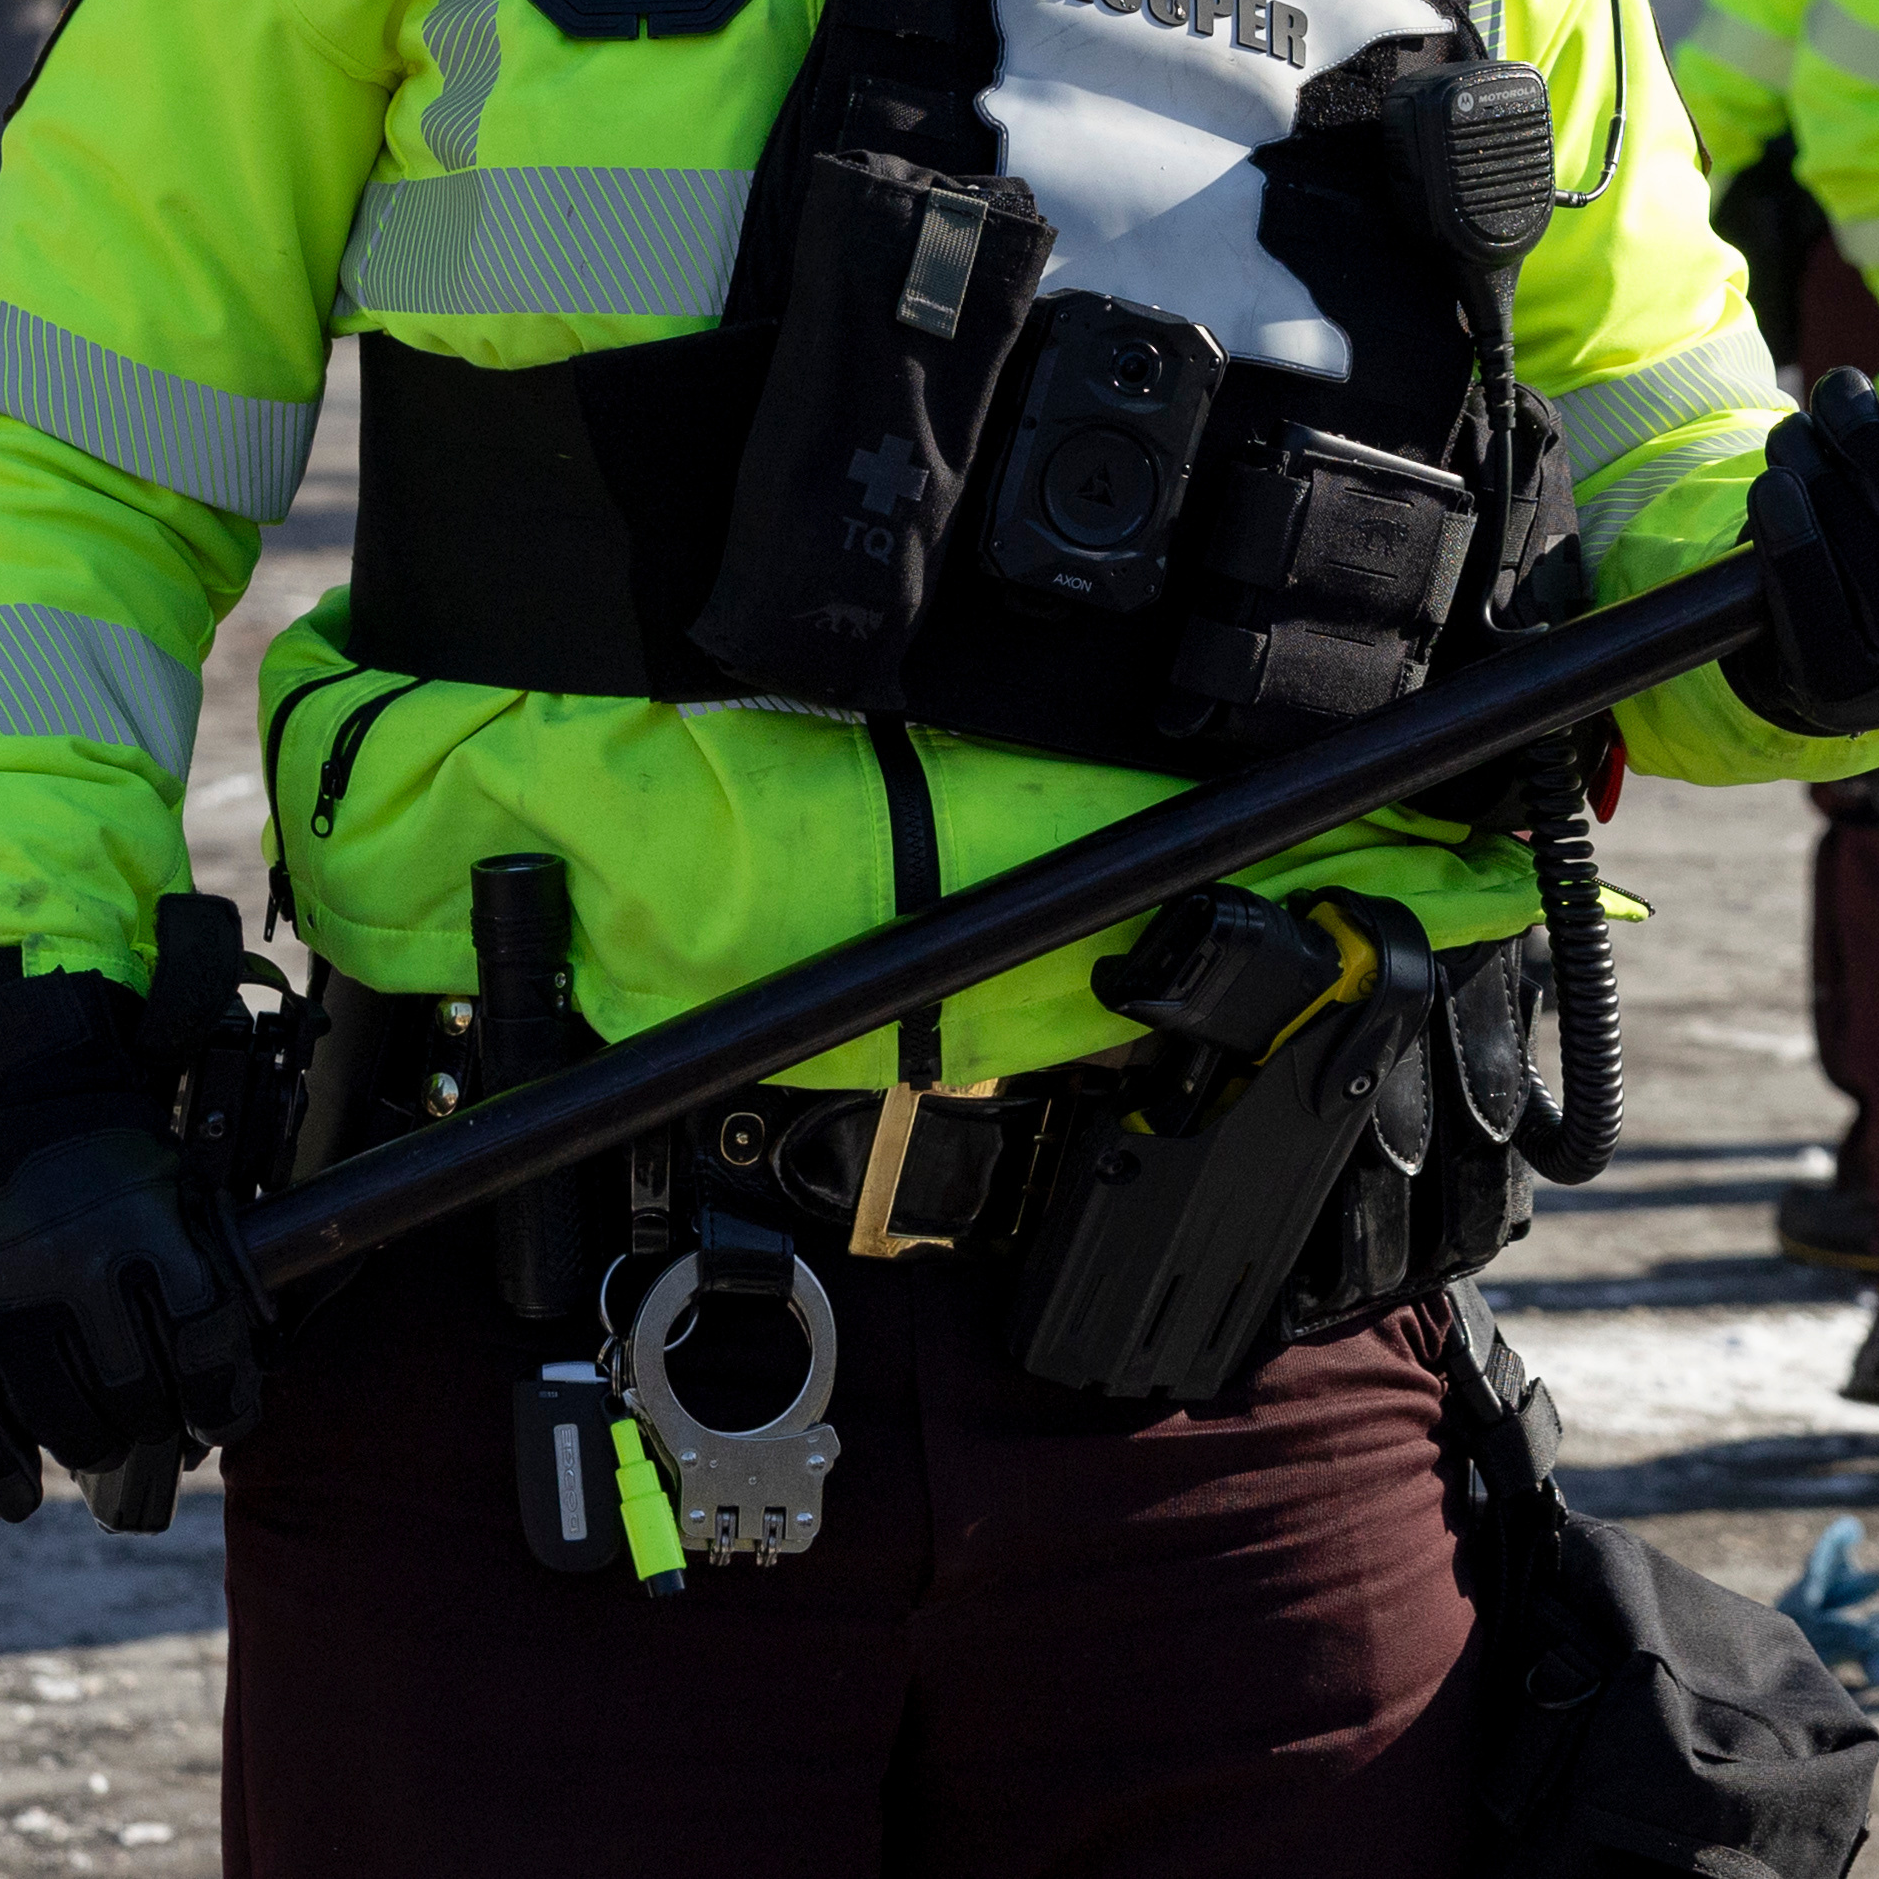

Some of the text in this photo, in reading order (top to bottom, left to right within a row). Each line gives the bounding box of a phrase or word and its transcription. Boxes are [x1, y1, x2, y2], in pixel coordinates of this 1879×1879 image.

[1478, 86, 1537, 103] MOTOROLA
[842, 516, 894, 566] TQ
[1053, 572, 1093, 593] AXON
